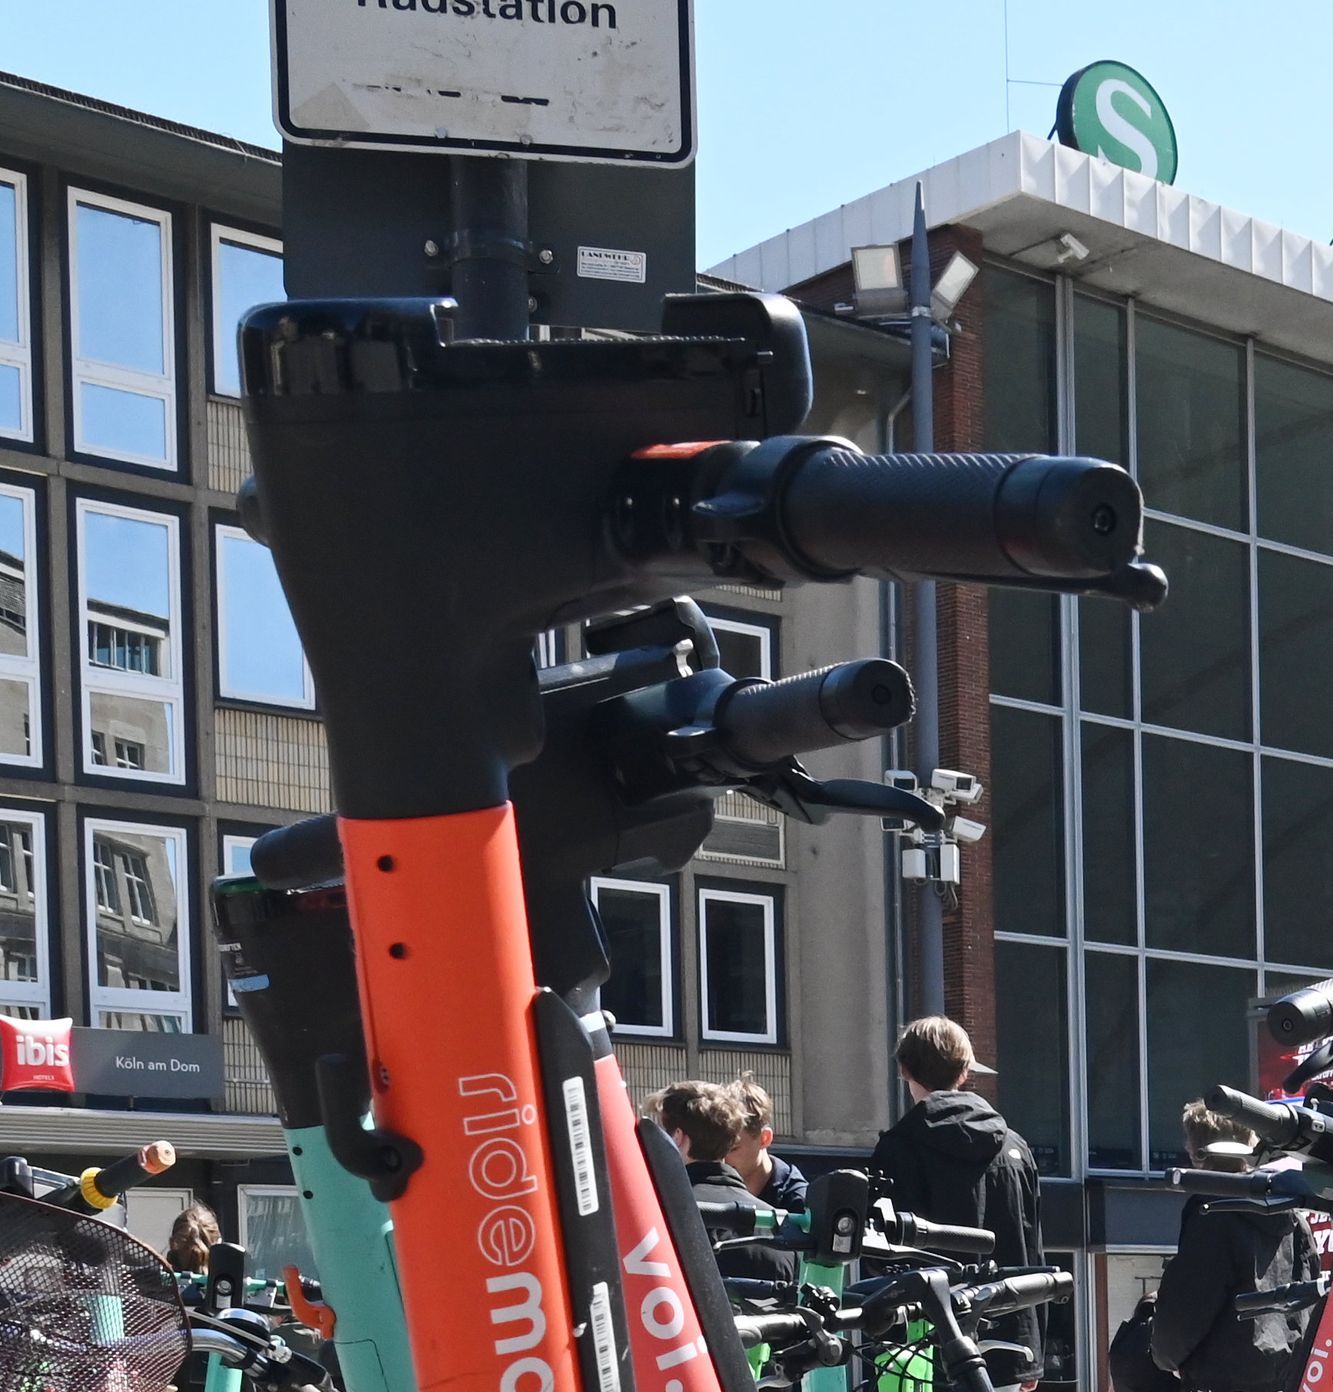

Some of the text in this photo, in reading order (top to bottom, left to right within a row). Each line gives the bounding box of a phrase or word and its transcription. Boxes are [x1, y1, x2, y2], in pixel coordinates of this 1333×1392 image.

[1096, 79, 1157, 181] S
[16, 1036, 70, 1067] ibis
[115, 1056, 200, 1073] Köln am Dom
